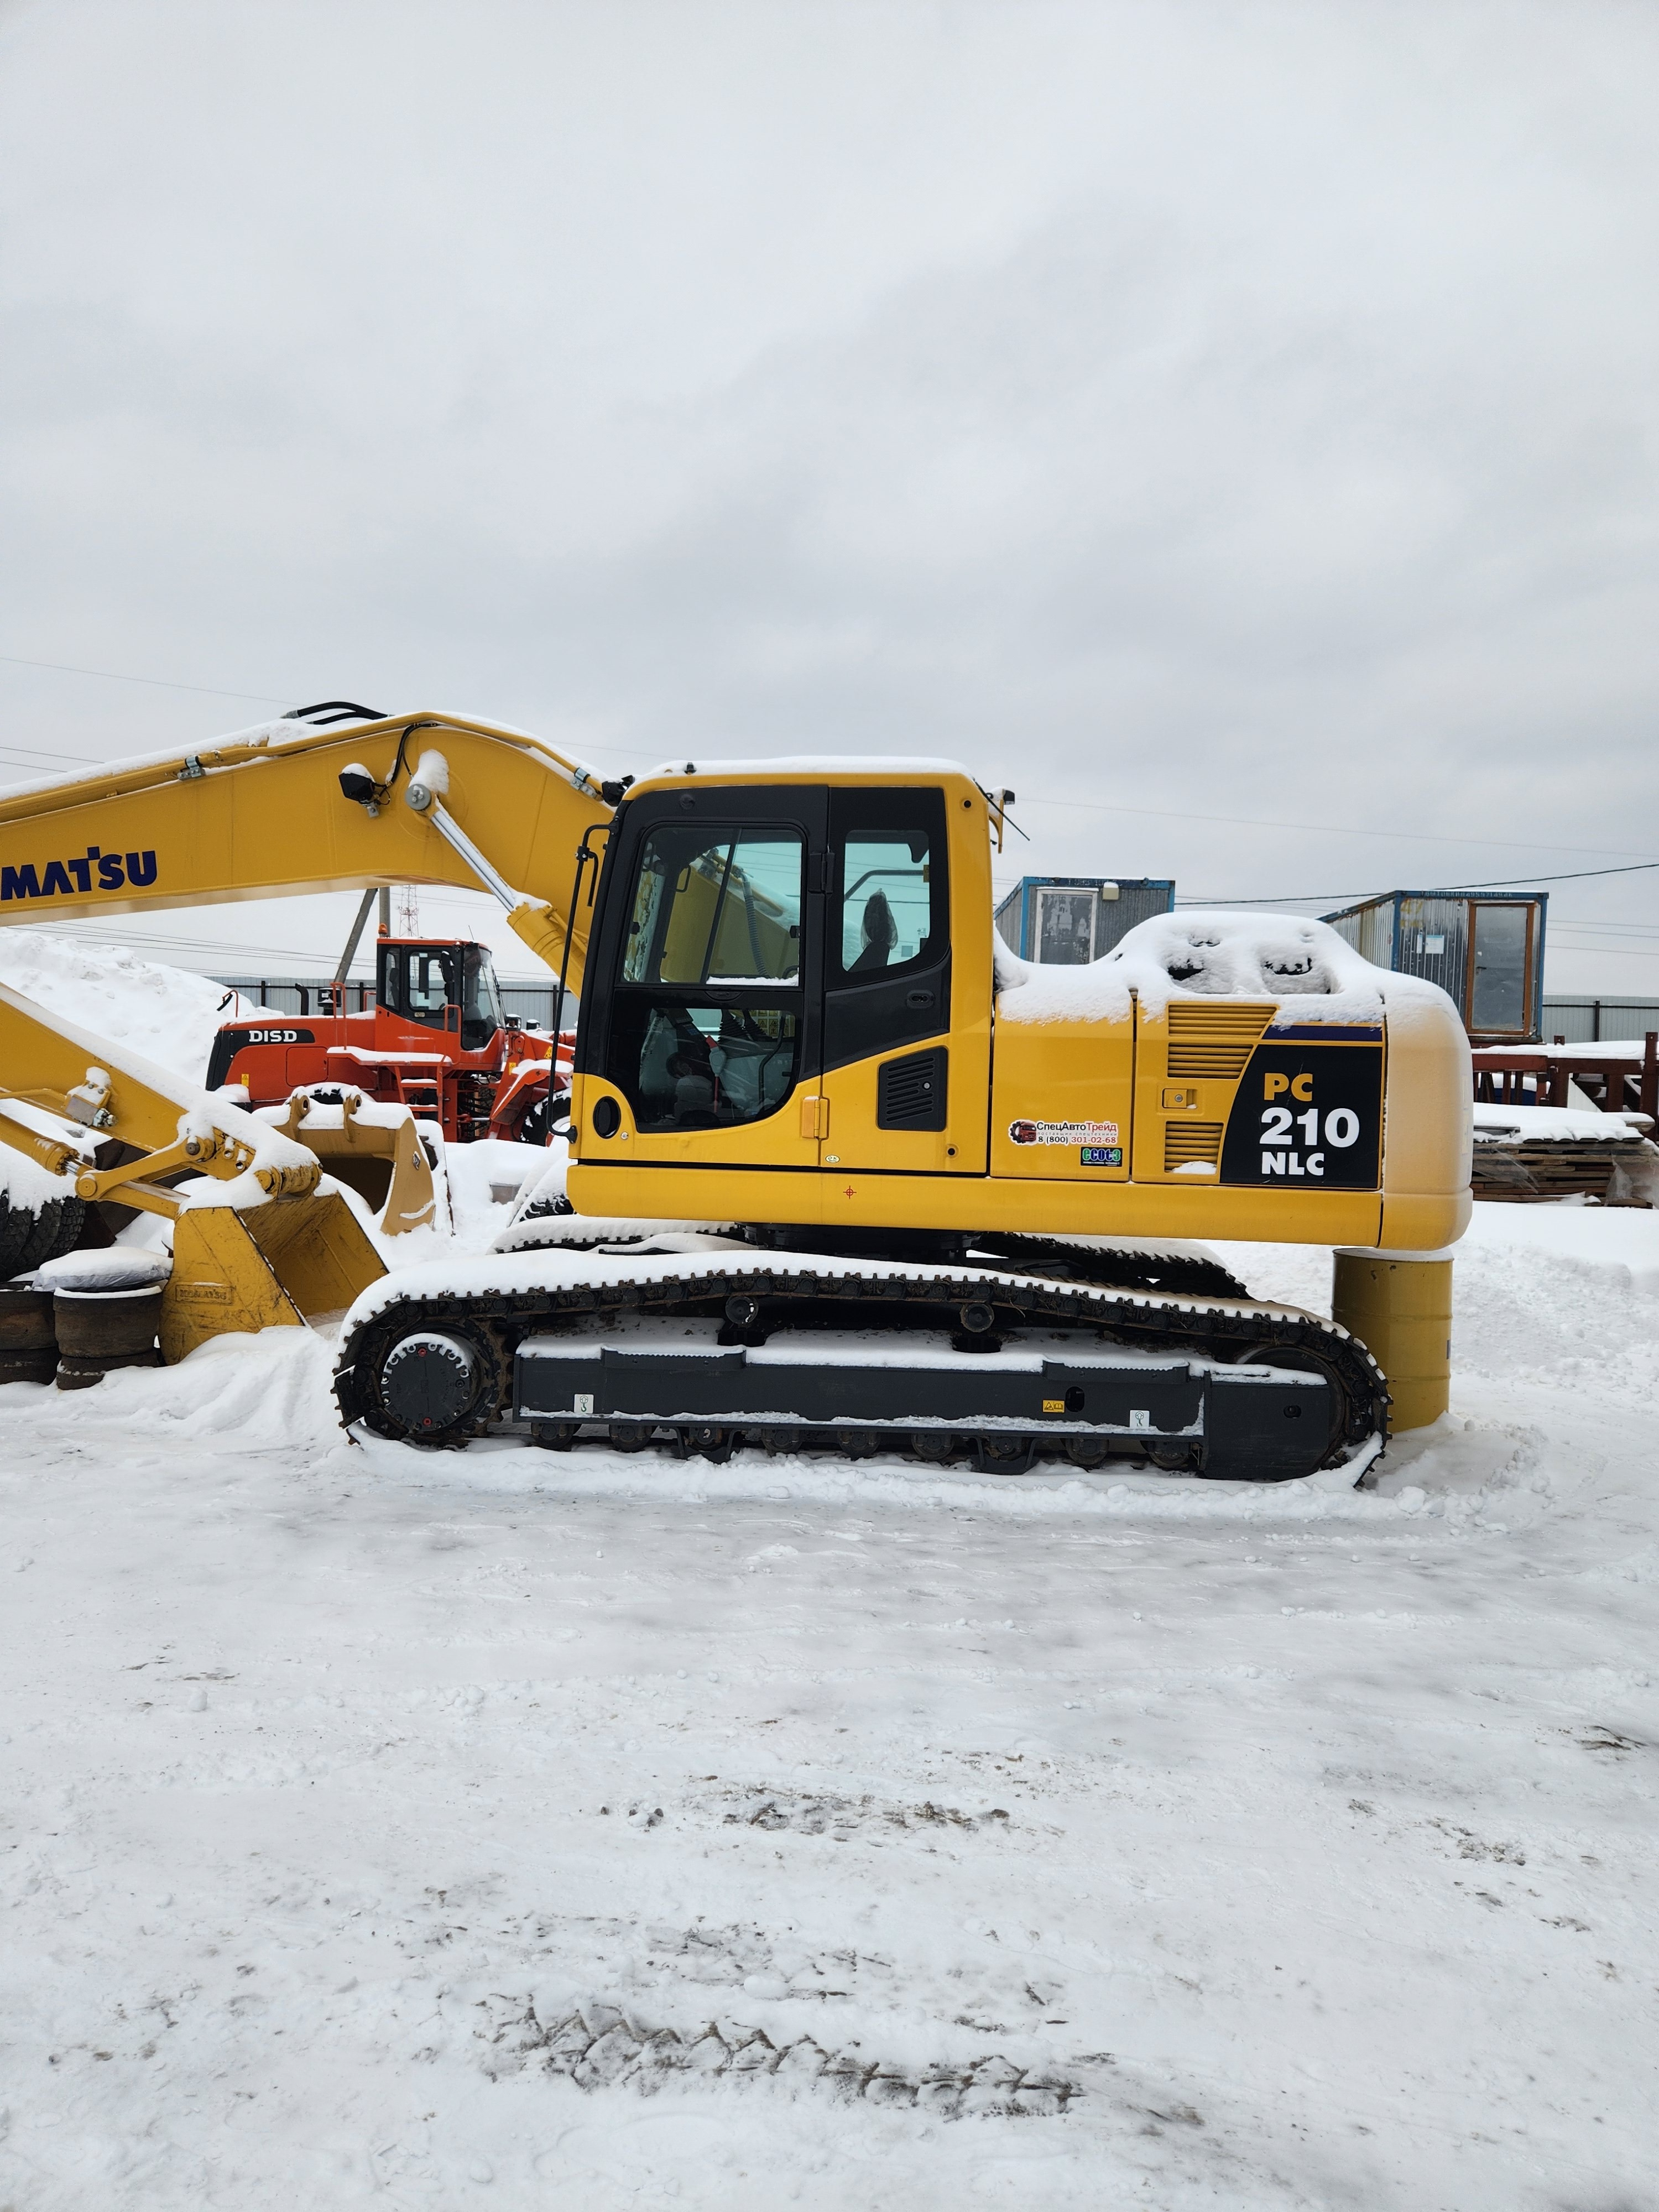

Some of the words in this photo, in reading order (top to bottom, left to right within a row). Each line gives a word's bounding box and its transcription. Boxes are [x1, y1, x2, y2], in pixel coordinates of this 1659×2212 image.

[1, 846, 158, 901] MATSU
[249, 1030, 298, 1042] DISD
[1264, 1072, 1313, 1102] PC
[1036, 1121, 1117, 1133] СпецАвтоТрейд
[1259, 1107, 1360, 1148] 210
[1261, 1151, 1324, 1176] NLC
